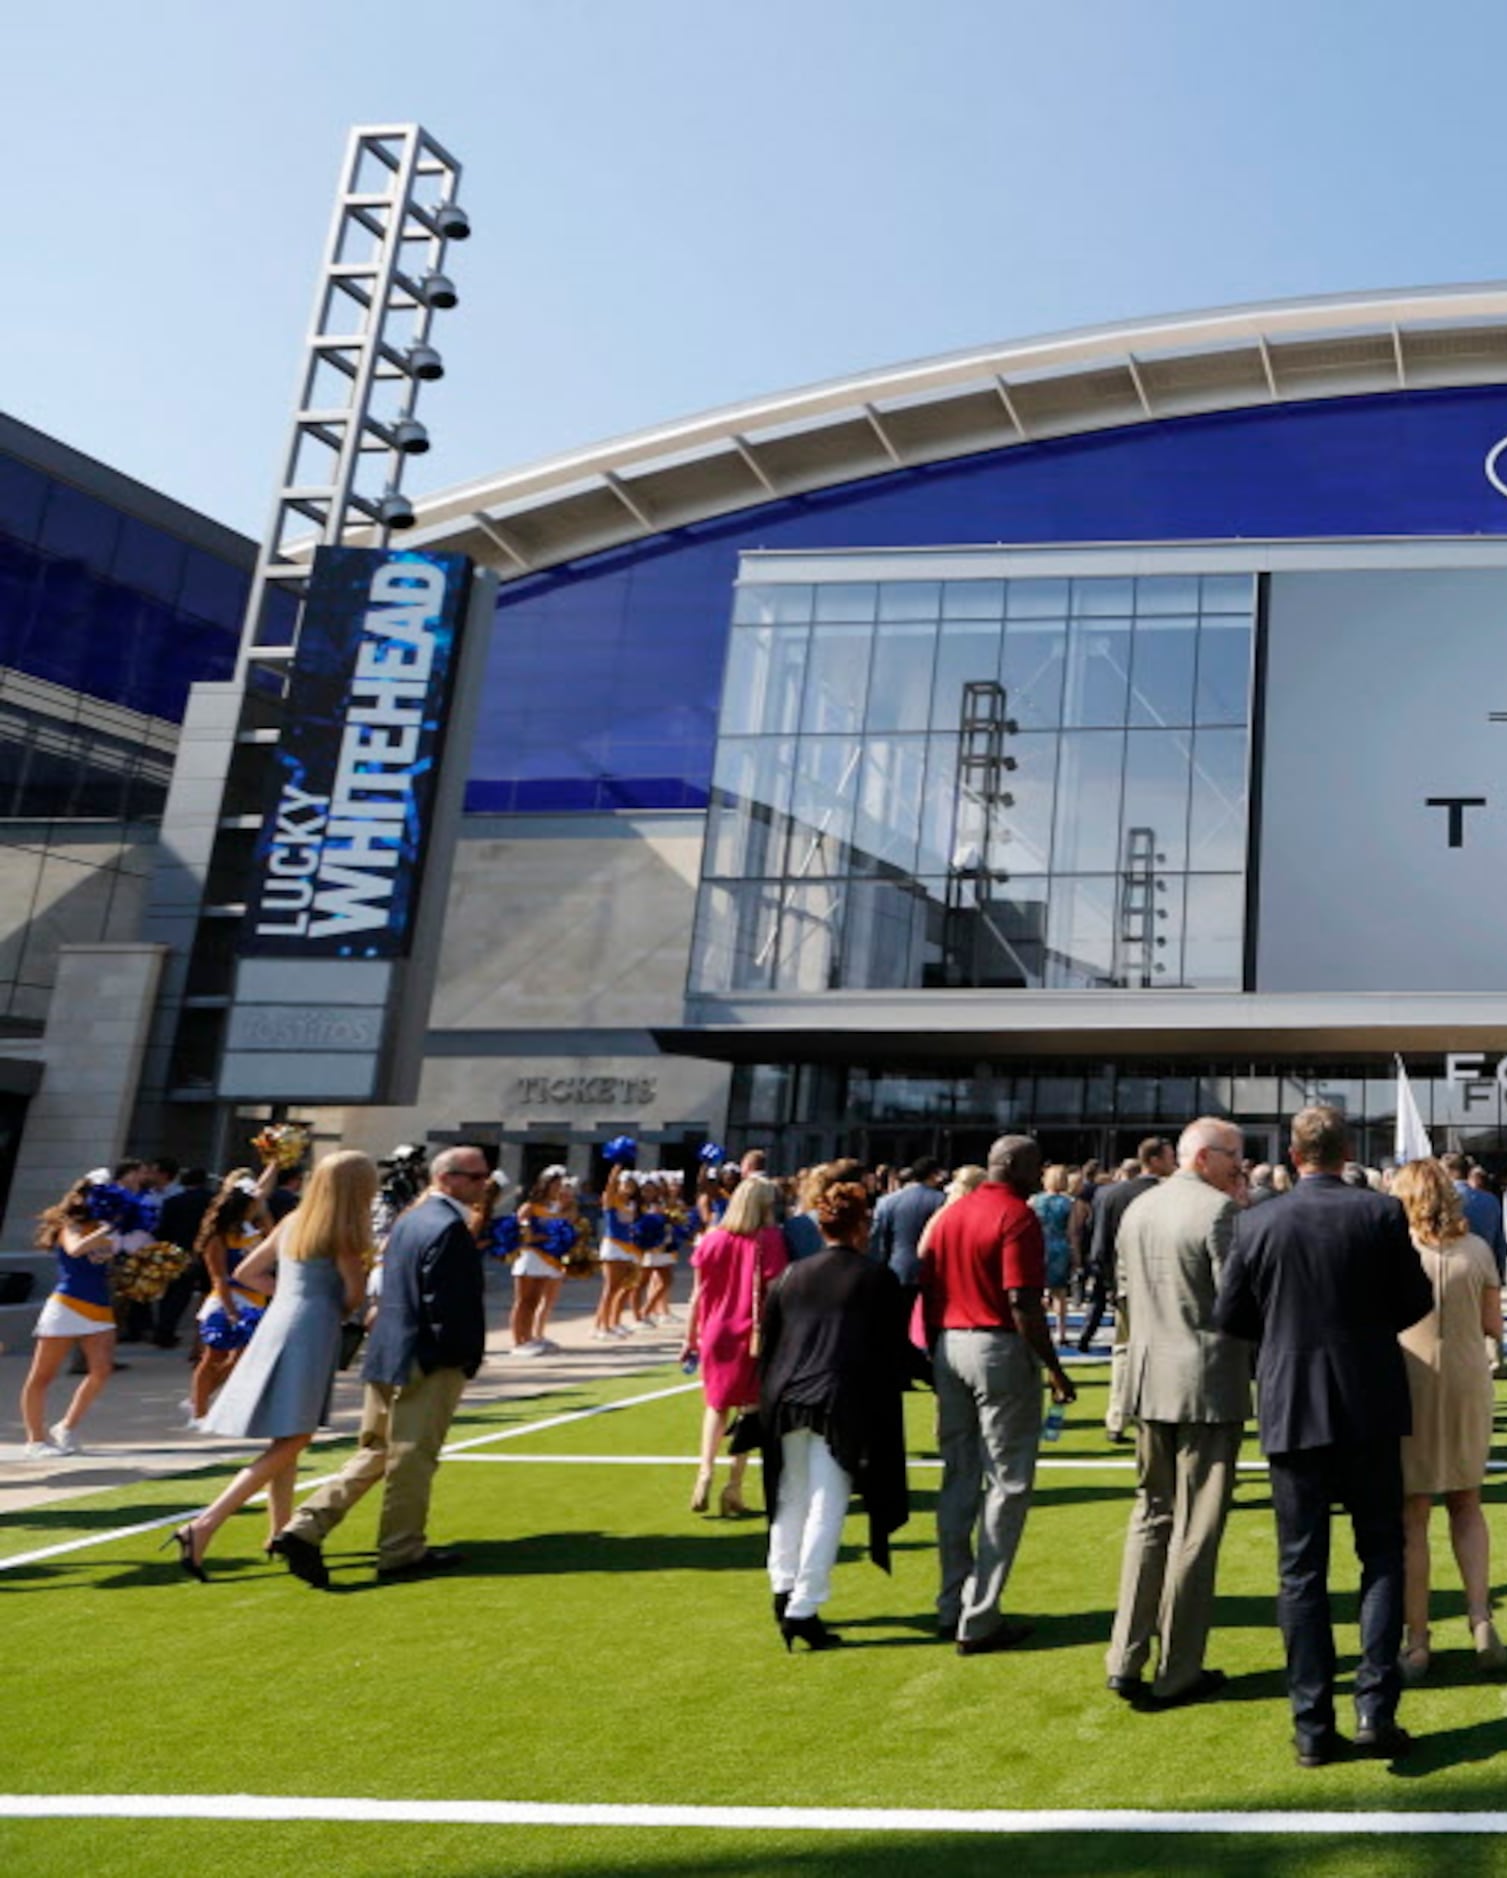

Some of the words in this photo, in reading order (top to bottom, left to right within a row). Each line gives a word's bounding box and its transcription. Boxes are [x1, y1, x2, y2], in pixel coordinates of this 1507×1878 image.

[307, 561, 449, 939] WHITEHEAD
[256, 784, 331, 936] LUCKY
[516, 1076, 659, 1106] TICKETS
